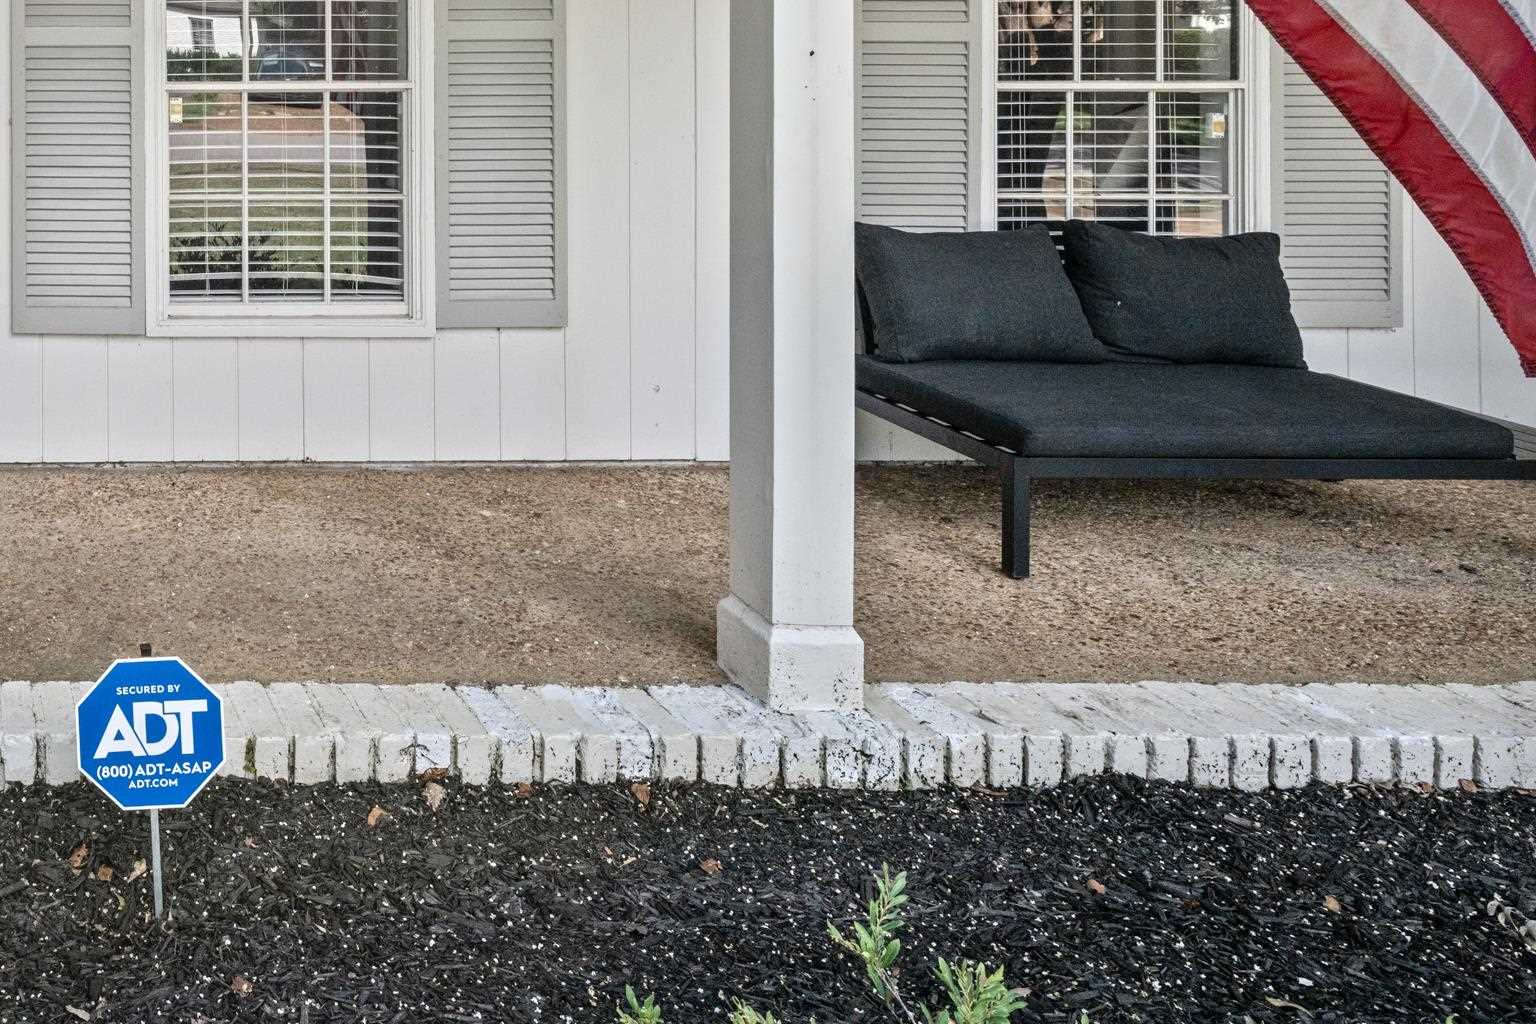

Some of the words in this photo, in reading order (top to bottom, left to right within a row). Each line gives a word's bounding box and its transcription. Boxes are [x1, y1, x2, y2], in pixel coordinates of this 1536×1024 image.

[116, 685, 165, 695] SECURED
[168, 684, 181, 693] BY
[93, 699, 208, 759] ADT
[96, 764, 133, 780] (800)
[135, 761, 212, 777] ADT-ASAP
[128, 778, 178, 789] ADT.COM
